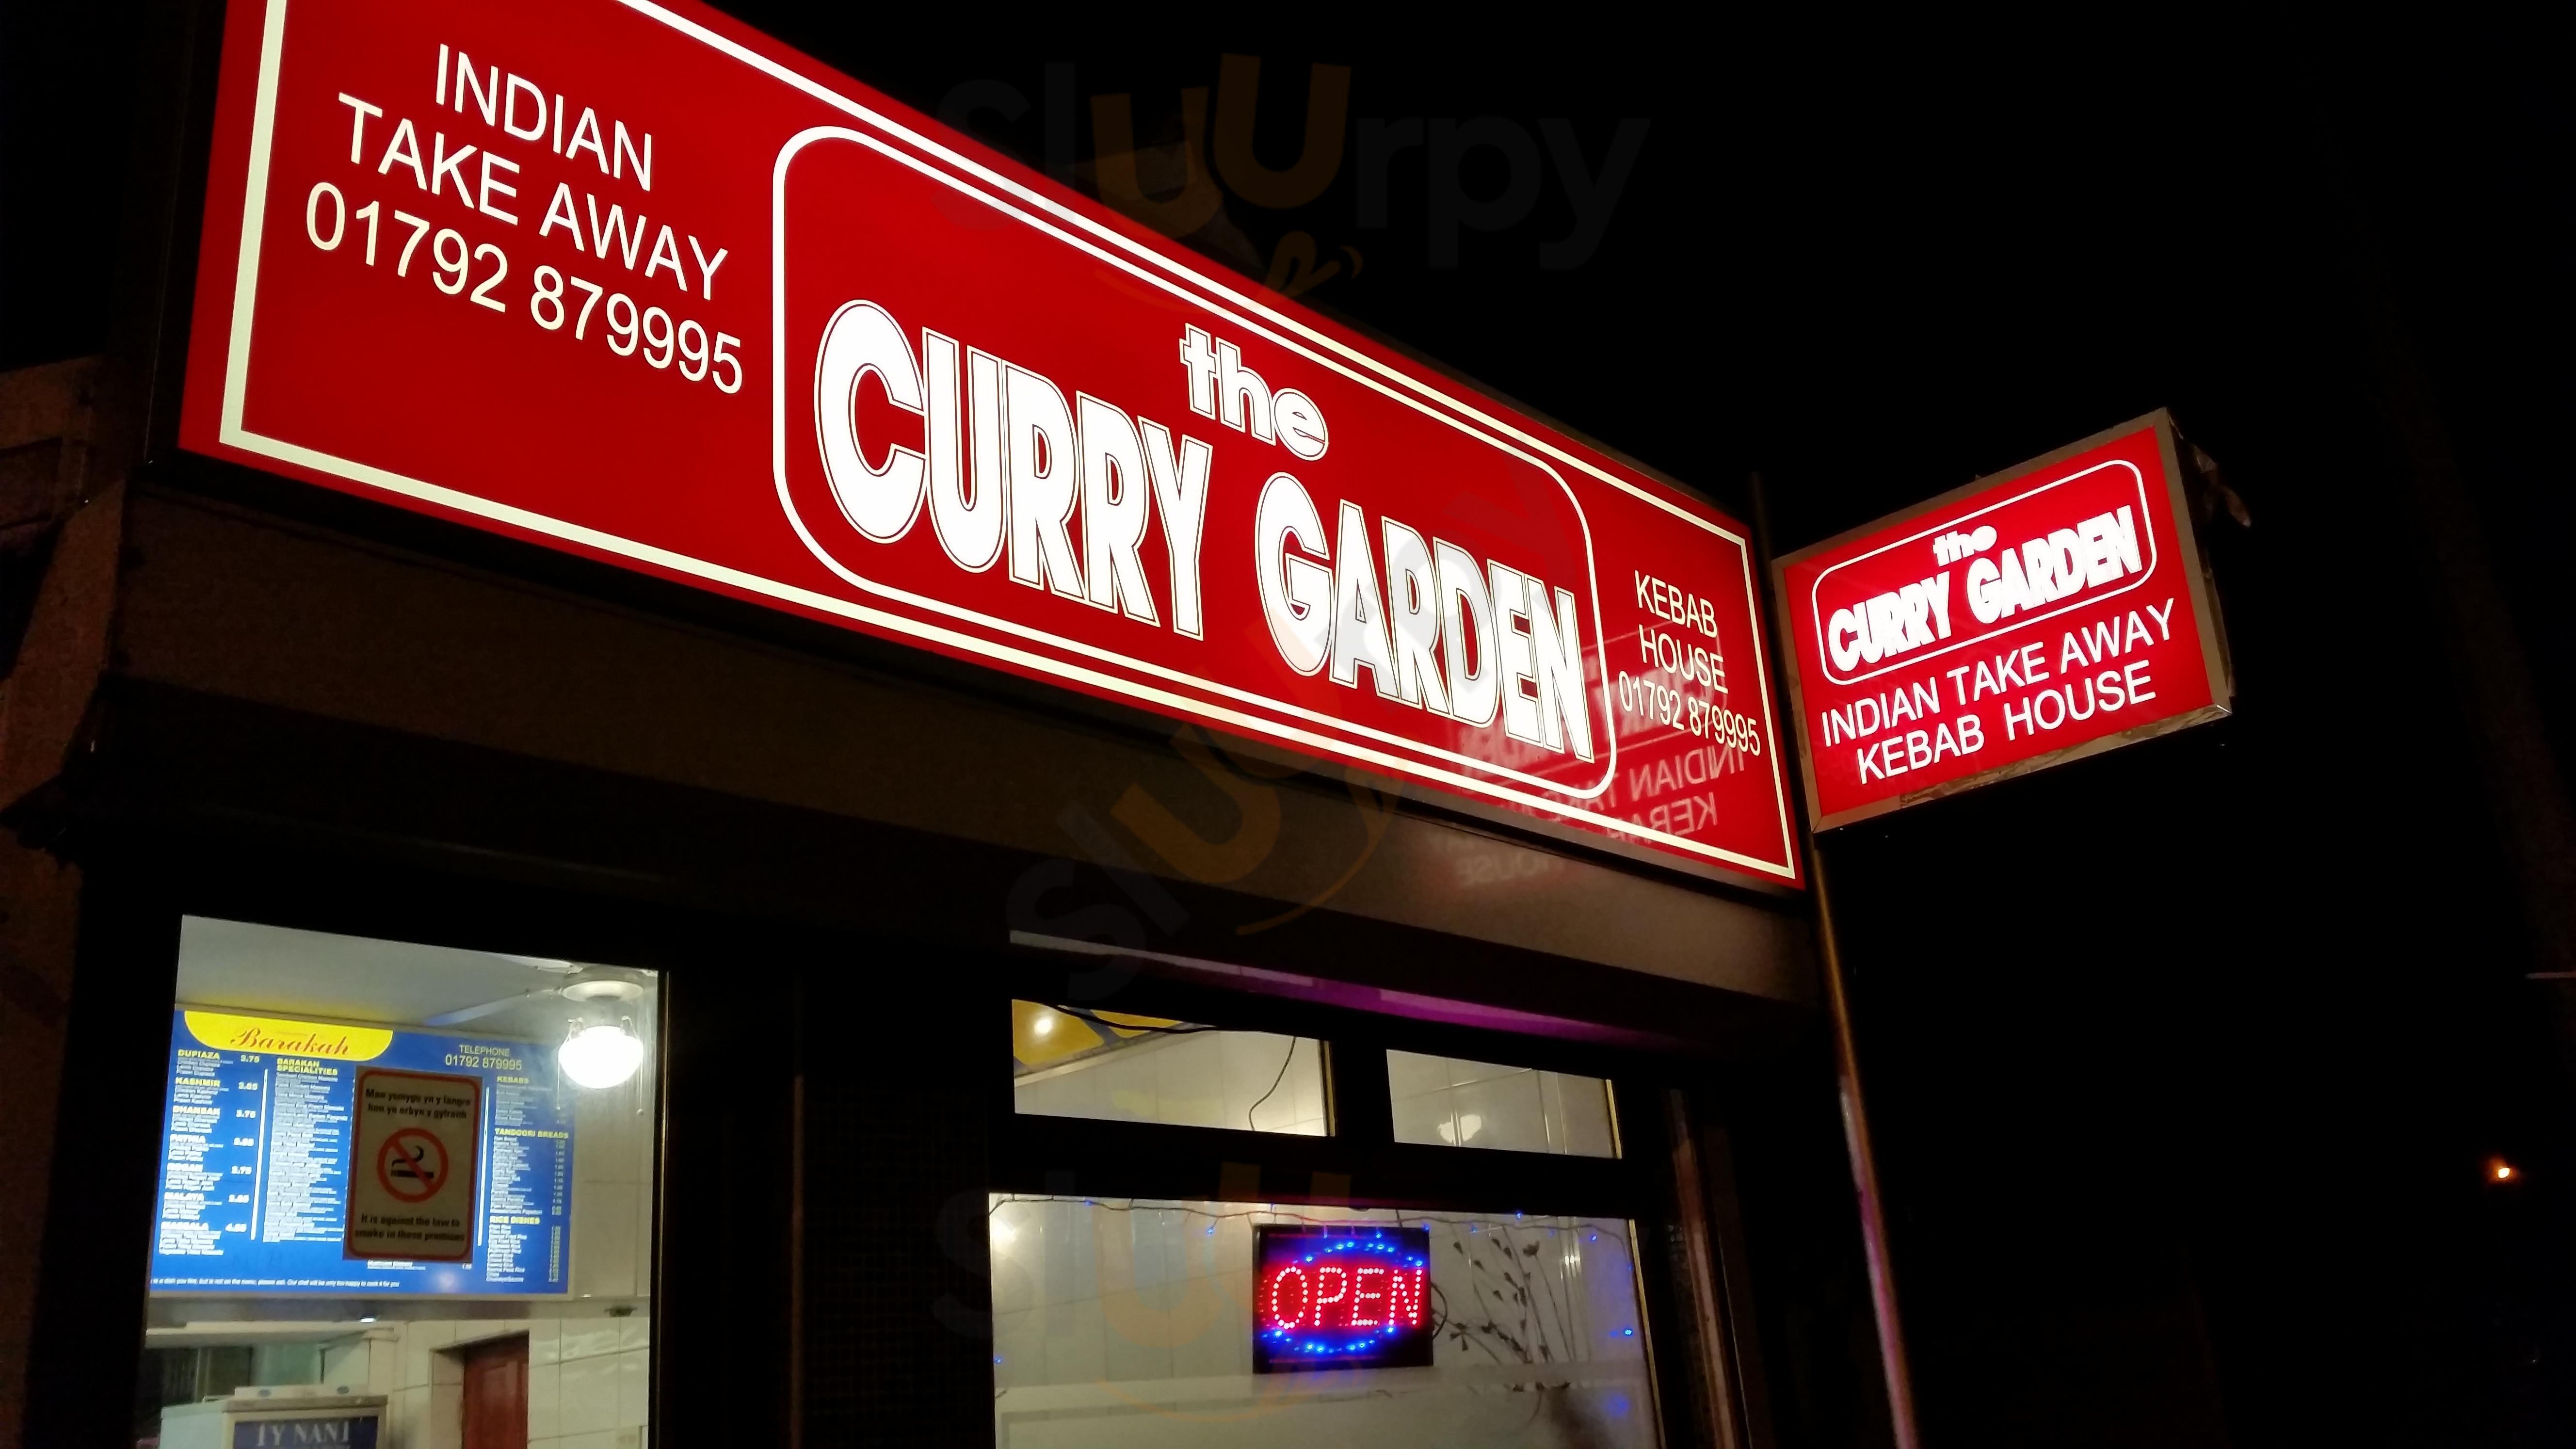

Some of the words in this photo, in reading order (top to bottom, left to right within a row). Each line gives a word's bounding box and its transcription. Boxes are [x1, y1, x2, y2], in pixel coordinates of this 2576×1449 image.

[435, 43, 652, 192] INDIAN
[338, 91, 520, 226] TAKE
[538, 181, 729, 301] AWAY
[306, 181, 508, 313] 01792
[530, 264, 743, 394] 879995
[1179, 323, 1329, 461] the
[814, 300, 1213, 641] CURRY
[1255, 472, 1594, 762] GARDEN
[1932, 525, 1997, 566] the
[1634, 570, 1718, 638] KEBAB
[1828, 571, 1952, 672] CURRY
[1966, 505, 2142, 624] GARDEN
[1639, 624, 1728, 694] HOUSE
[1821, 676, 1940, 747] INDIAN
[1946, 642, 2050, 706] TAKE
[2061, 597, 2174, 674] AWAY
[1619, 671, 1685, 730] 01792
[1688, 696, 1761, 756] 879995
[1857, 714, 1984, 785] KEBAB
[2003, 659, 2156, 741] HOUSE
[230, 1028, 348, 1055] Barakah
[445, 1054, 479, 1068] 01792
[483, 1057, 522, 1070] 879995
[459, 1044, 510, 1057] TELEPHONE
[361, 1213, 368, 1223] It
[370, 1215, 378, 1224] is
[416, 1216, 430, 1226] the
[432, 1217, 449, 1226] law
[1271, 1266, 1422, 1330] OPEN
